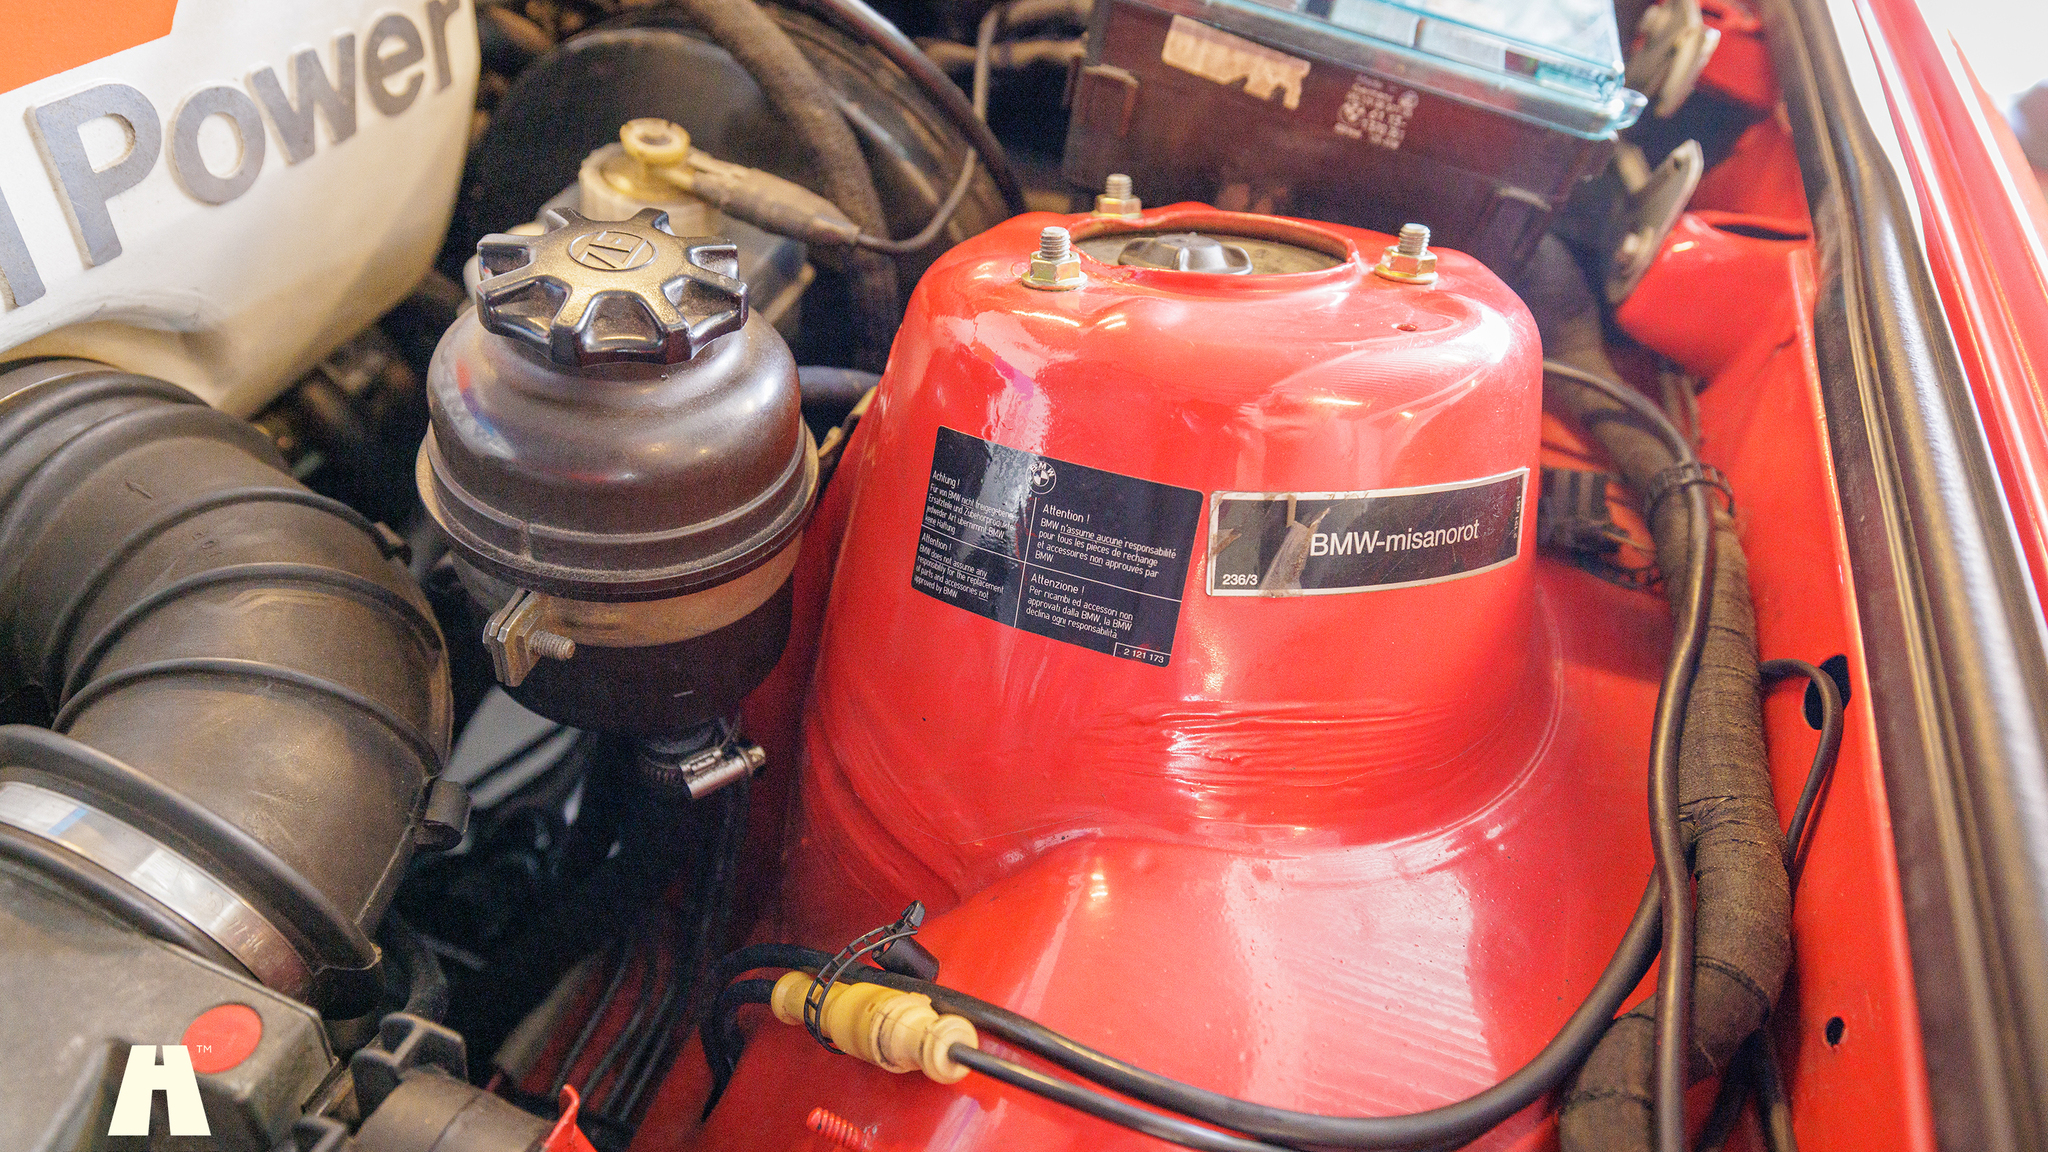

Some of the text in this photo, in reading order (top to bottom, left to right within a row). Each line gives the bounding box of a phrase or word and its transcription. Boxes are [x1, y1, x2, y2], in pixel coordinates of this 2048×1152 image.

[28, 0, 461, 269] Power
[932, 470, 957, 489] Achtung
[928, 493, 953, 510] Ersatzteile
[953, 503, 963, 514] und
[948, 490, 962, 501] BMW
[961, 496, 975, 508] nicht
[1042, 504, 1084, 523] Attention
[936, 518, 956, 535] Haftung
[948, 513, 957, 523] Art
[988, 526, 1005, 539] BMW
[921, 532, 948, 551] Attention
[1038, 530, 1159, 568] pour tous les pièces de rechange
[1040, 517, 1177, 559] BMW n'assume aucune responsabilité
[1309, 519, 1480, 557] BMW-misanorot
[919, 543, 988, 580] BMW does not assume any
[1034, 550, 1054, 562] BMW
[1036, 540, 1160, 578] et accessoires non approuvés par
[914, 575, 959, 598] approved by BMW
[915, 565, 989, 600] of parts and accessories not
[946, 567, 956, 577] for
[956, 570, 966, 581] the
[966, 575, 1004, 595] replacement
[1031, 573, 1079, 594] Attenzione
[1222, 573, 1258, 586] 236/3
[1027, 597, 1133, 631] approvati dalla BMW, la BMW
[1029, 585, 1134, 621] Per ricambi ed accessori non
[1025, 606, 1050, 620] declina
[1051, 615, 1067, 626] ogni
[1123, 647, 1164, 664] 2 121 173
